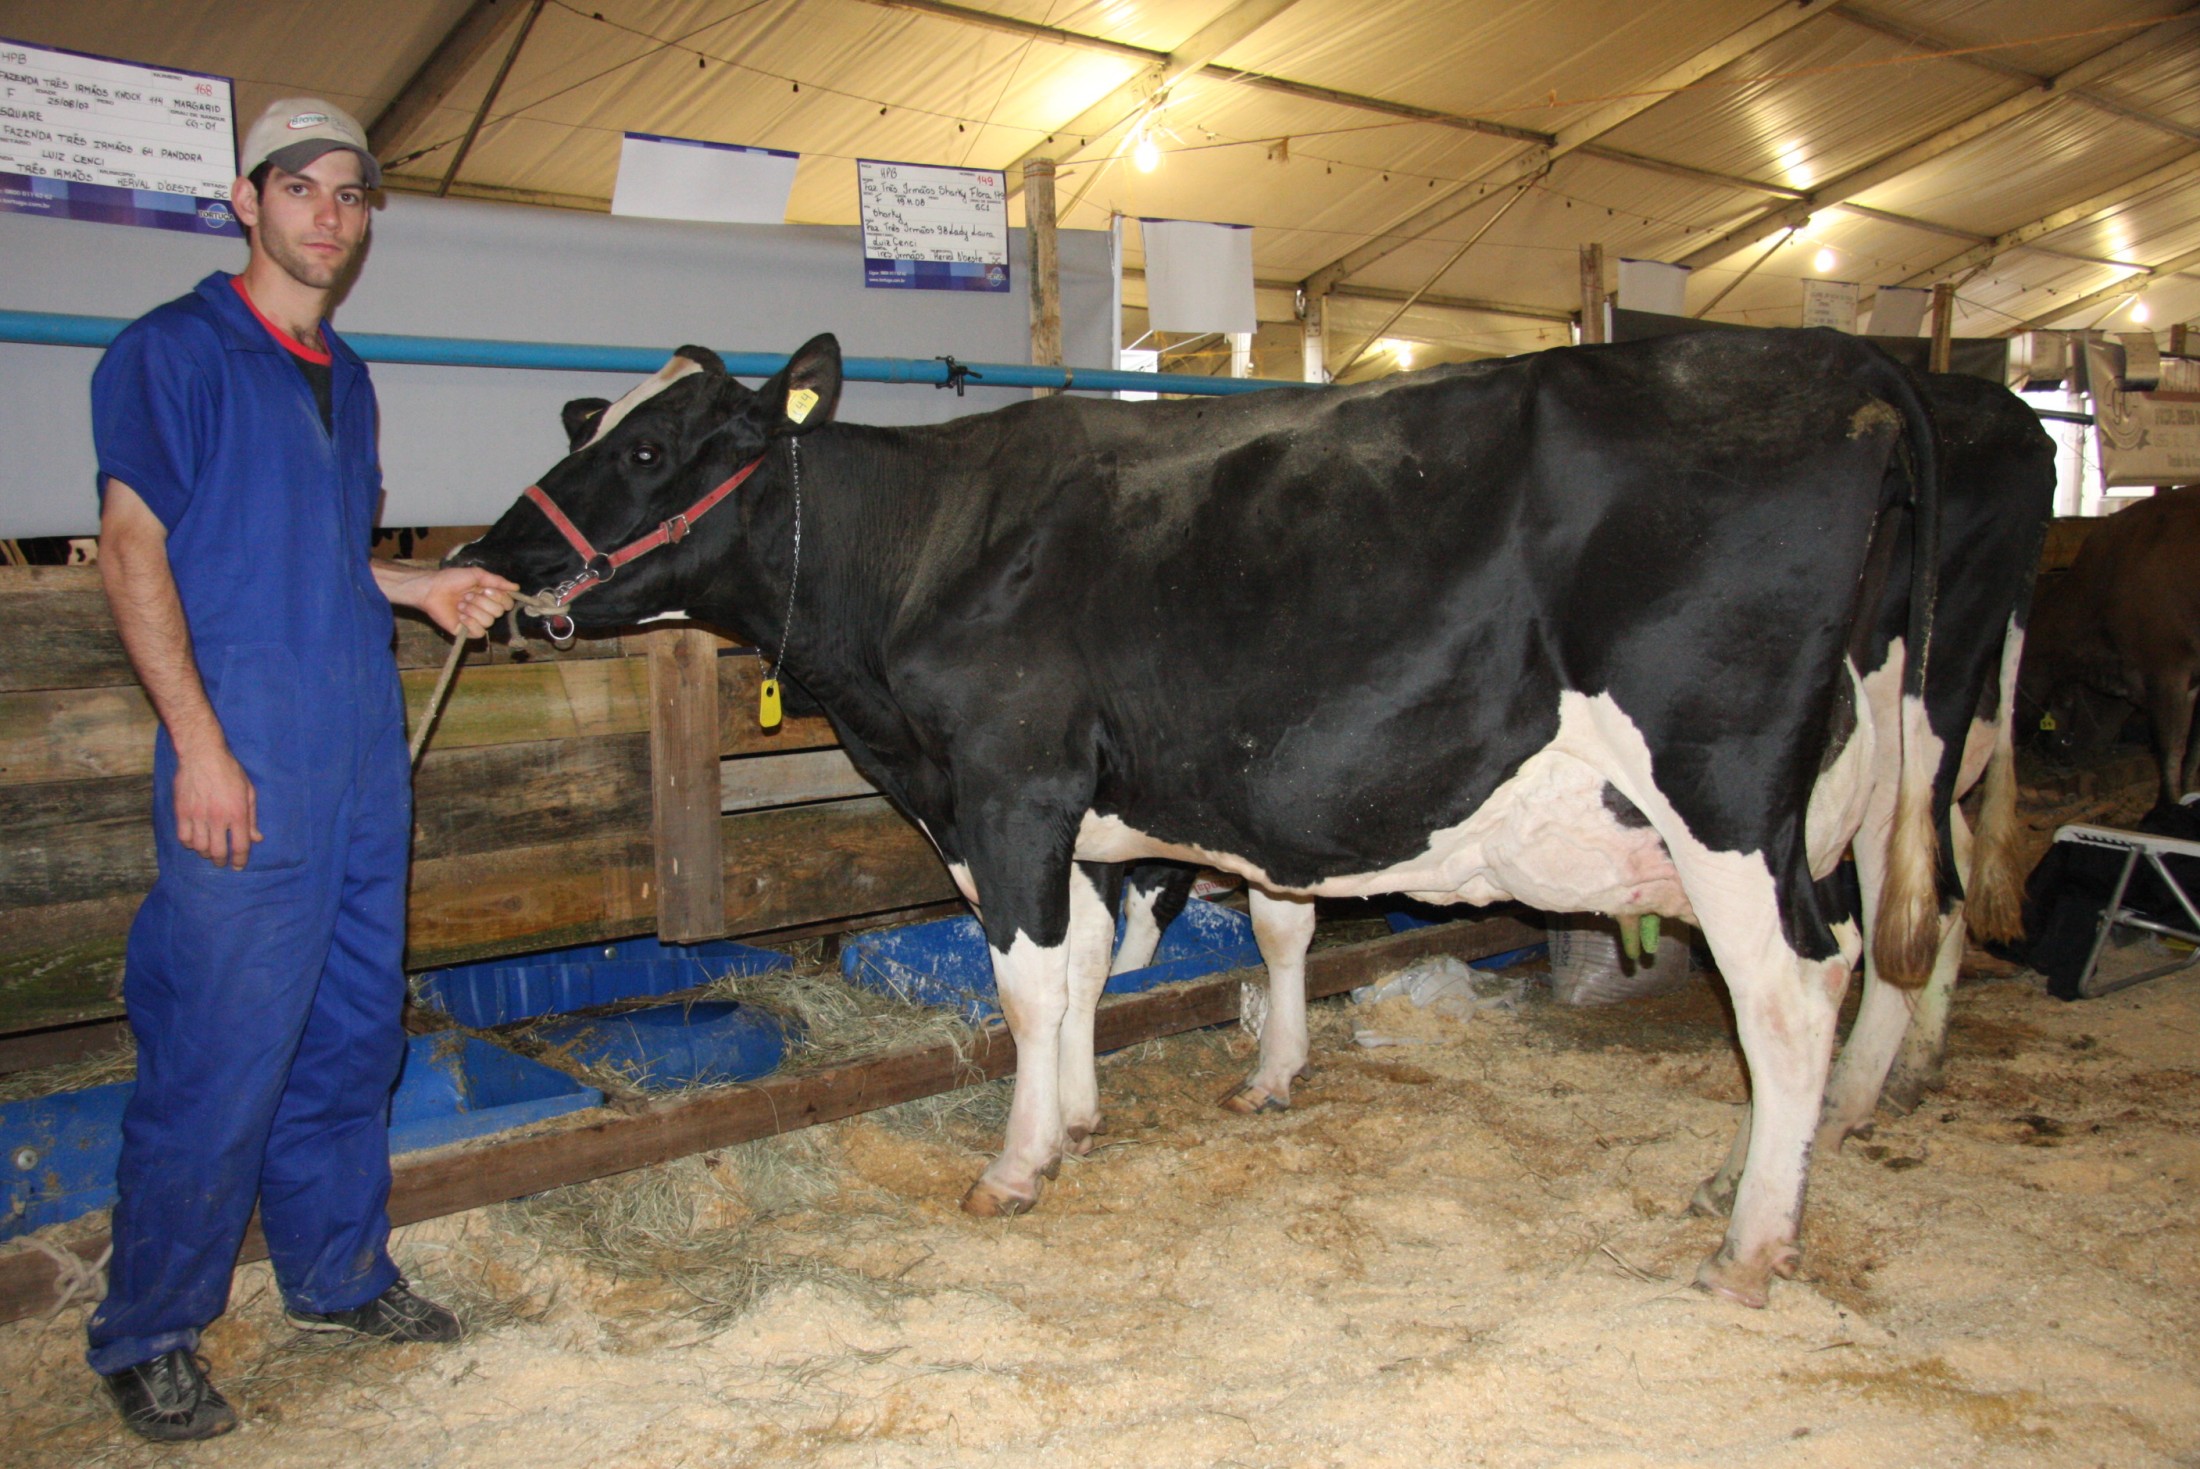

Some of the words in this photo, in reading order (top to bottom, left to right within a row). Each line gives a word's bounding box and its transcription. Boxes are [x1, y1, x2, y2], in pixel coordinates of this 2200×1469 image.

[1, 52, 27, 65] HPB
[7, 88, 15, 98] F
[194, 83, 213, 97] 168
[0, 106, 43, 122] SQUARE
[3, 125, 53, 141] FAZENDA
[161, 149, 203, 162] PANDORA
[42, 150, 65, 161] LUIZ
[73, 154, 105, 166] CENCI
[977, 175, 993, 186] 149
[198, 210, 236, 222] TORTUGA
